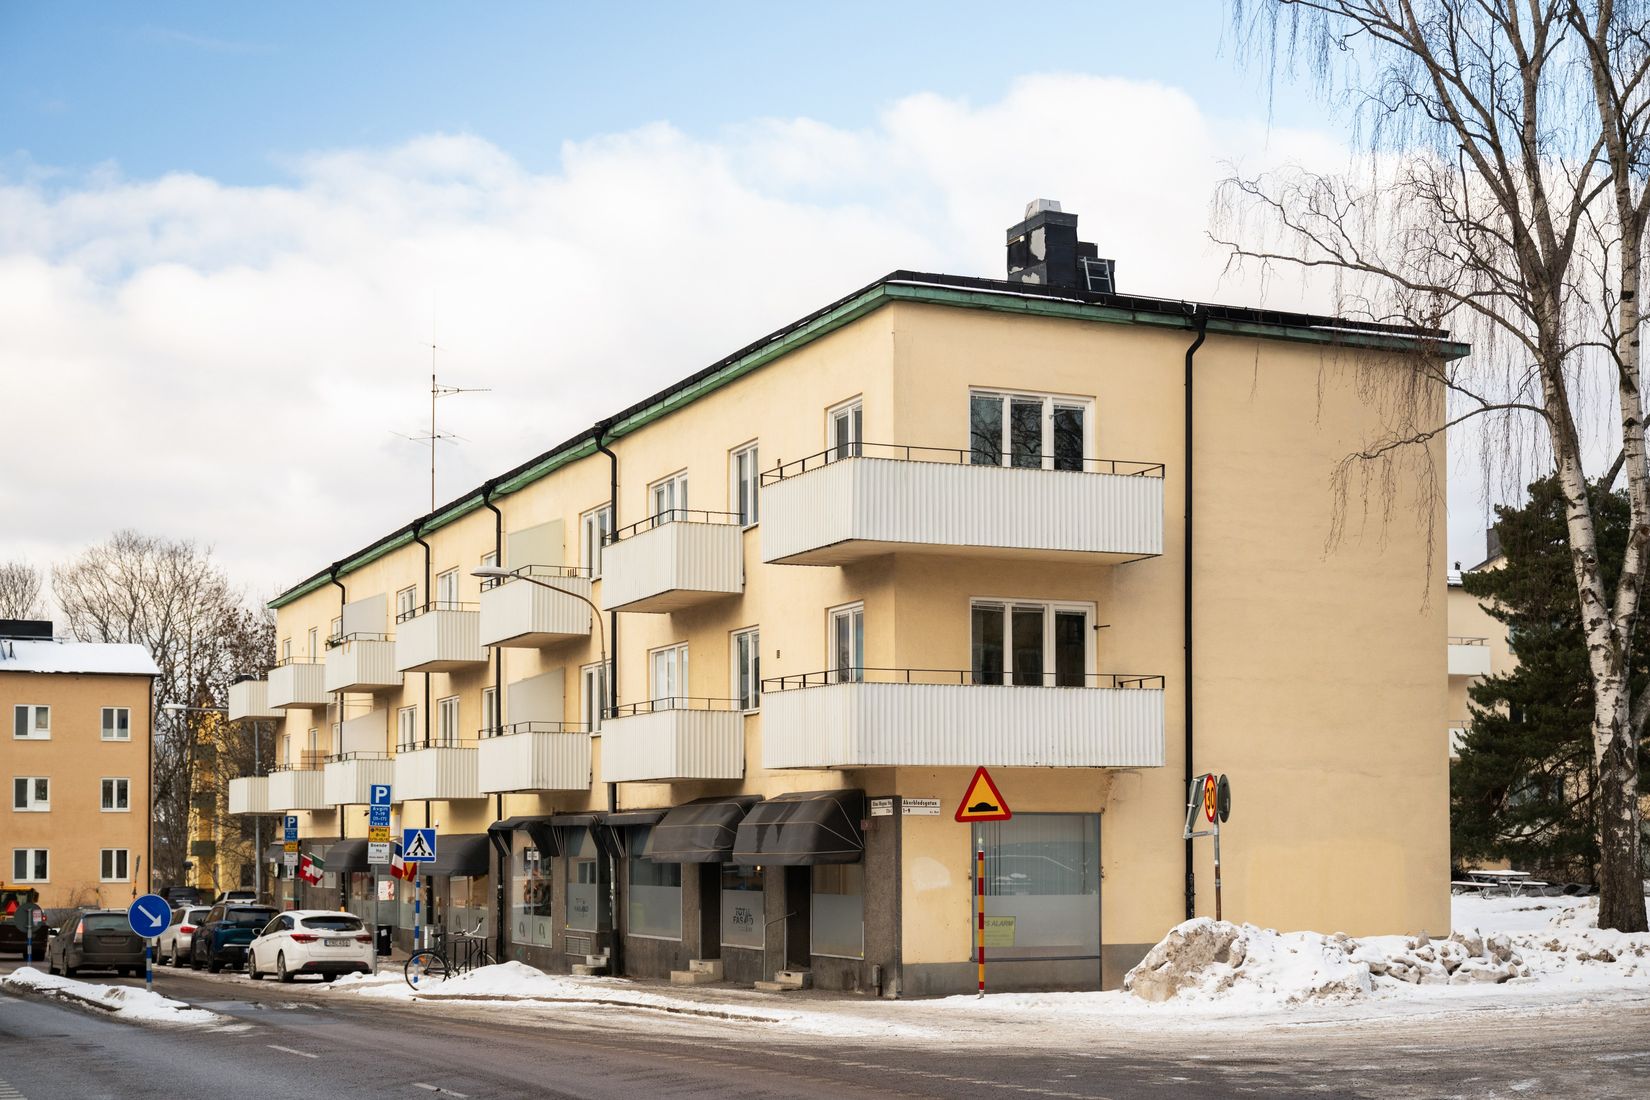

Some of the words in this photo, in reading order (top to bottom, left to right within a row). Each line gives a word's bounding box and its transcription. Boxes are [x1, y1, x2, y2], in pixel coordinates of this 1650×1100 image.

[376, 786, 388, 804] P
[1207, 786, 1215, 810] 30
[287, 817, 296, 828] P
